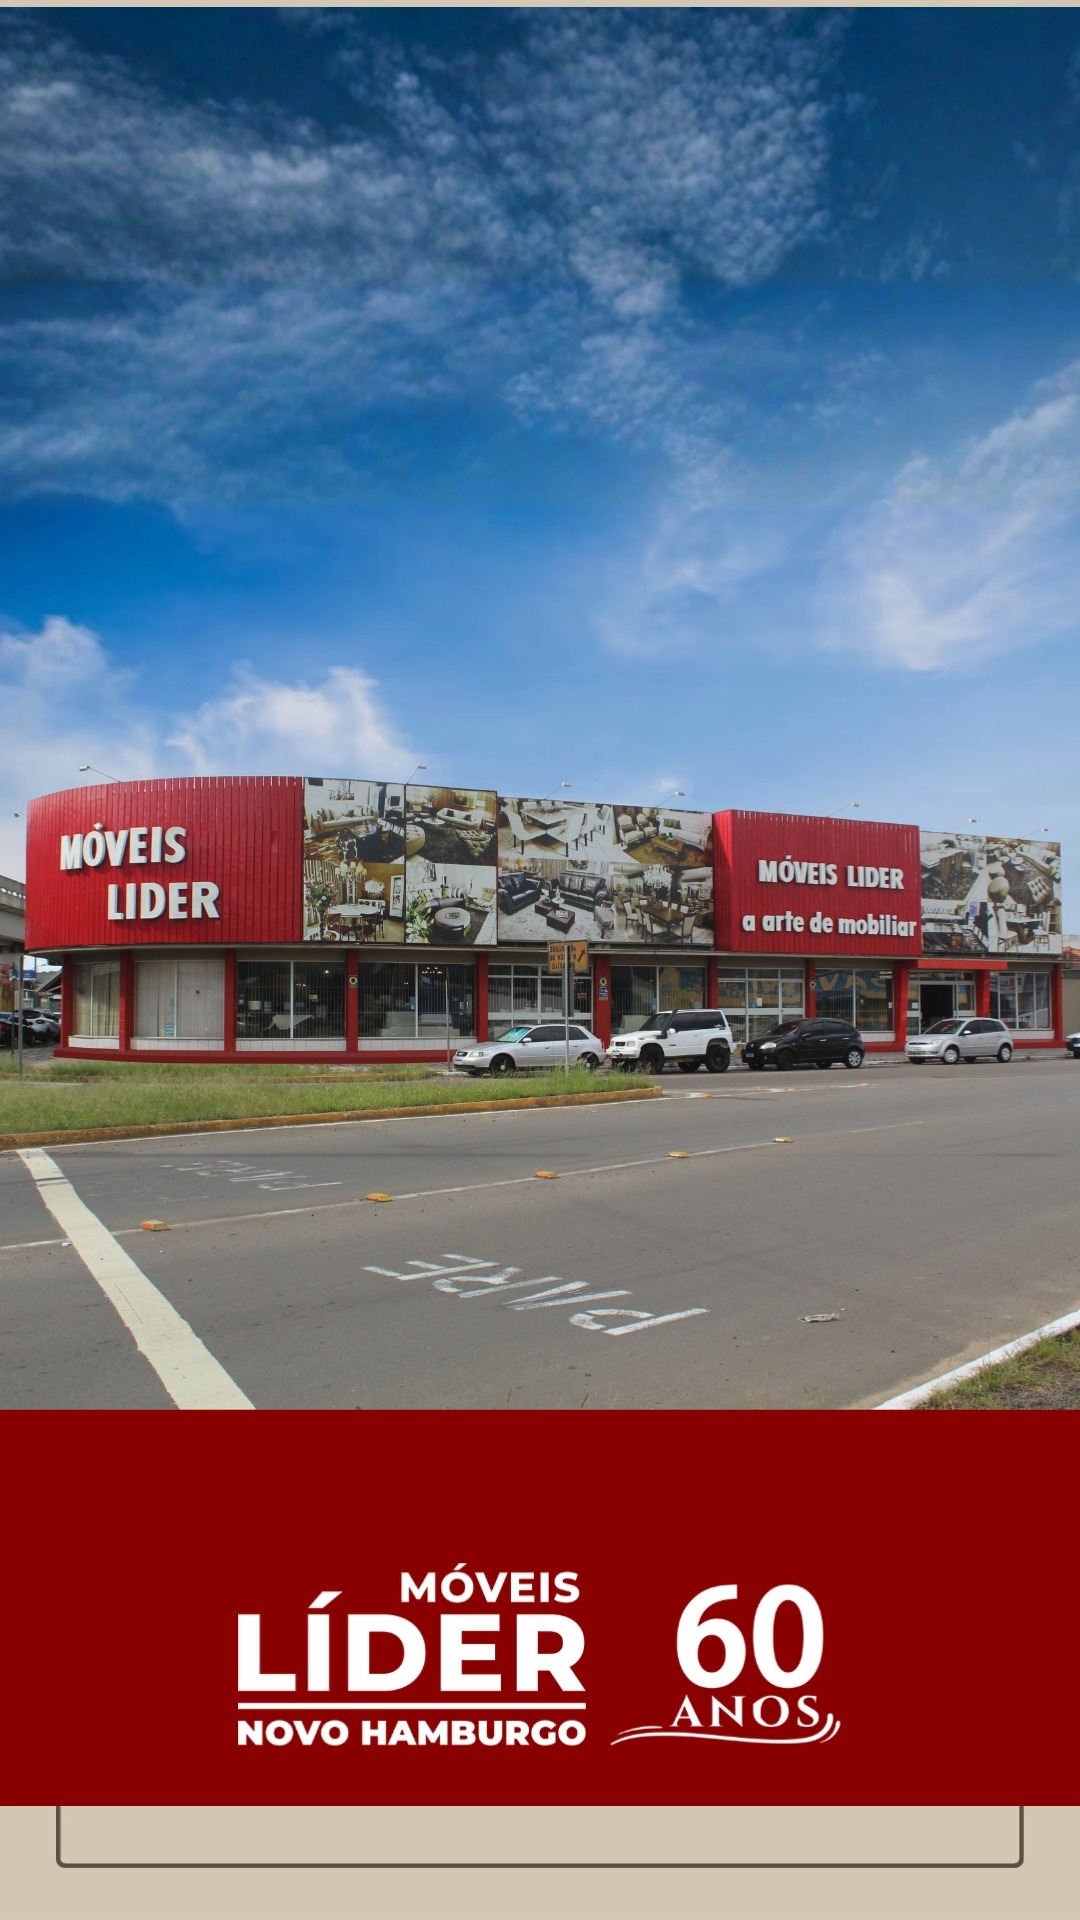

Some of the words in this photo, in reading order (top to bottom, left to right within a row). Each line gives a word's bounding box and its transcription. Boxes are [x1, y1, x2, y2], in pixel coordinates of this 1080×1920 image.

[60, 822, 187, 870] MÓVEIS
[758, 854, 838, 886] MÓVEIS
[847, 865, 905, 890] LIDER
[107, 881, 220, 920] LIDER
[742, 914, 756, 932] a
[762, 910, 805, 932] arte
[809, 911, 834, 934] de
[838, 913, 917, 937] mobiliar
[360, 1253, 710, 1336] PARE
